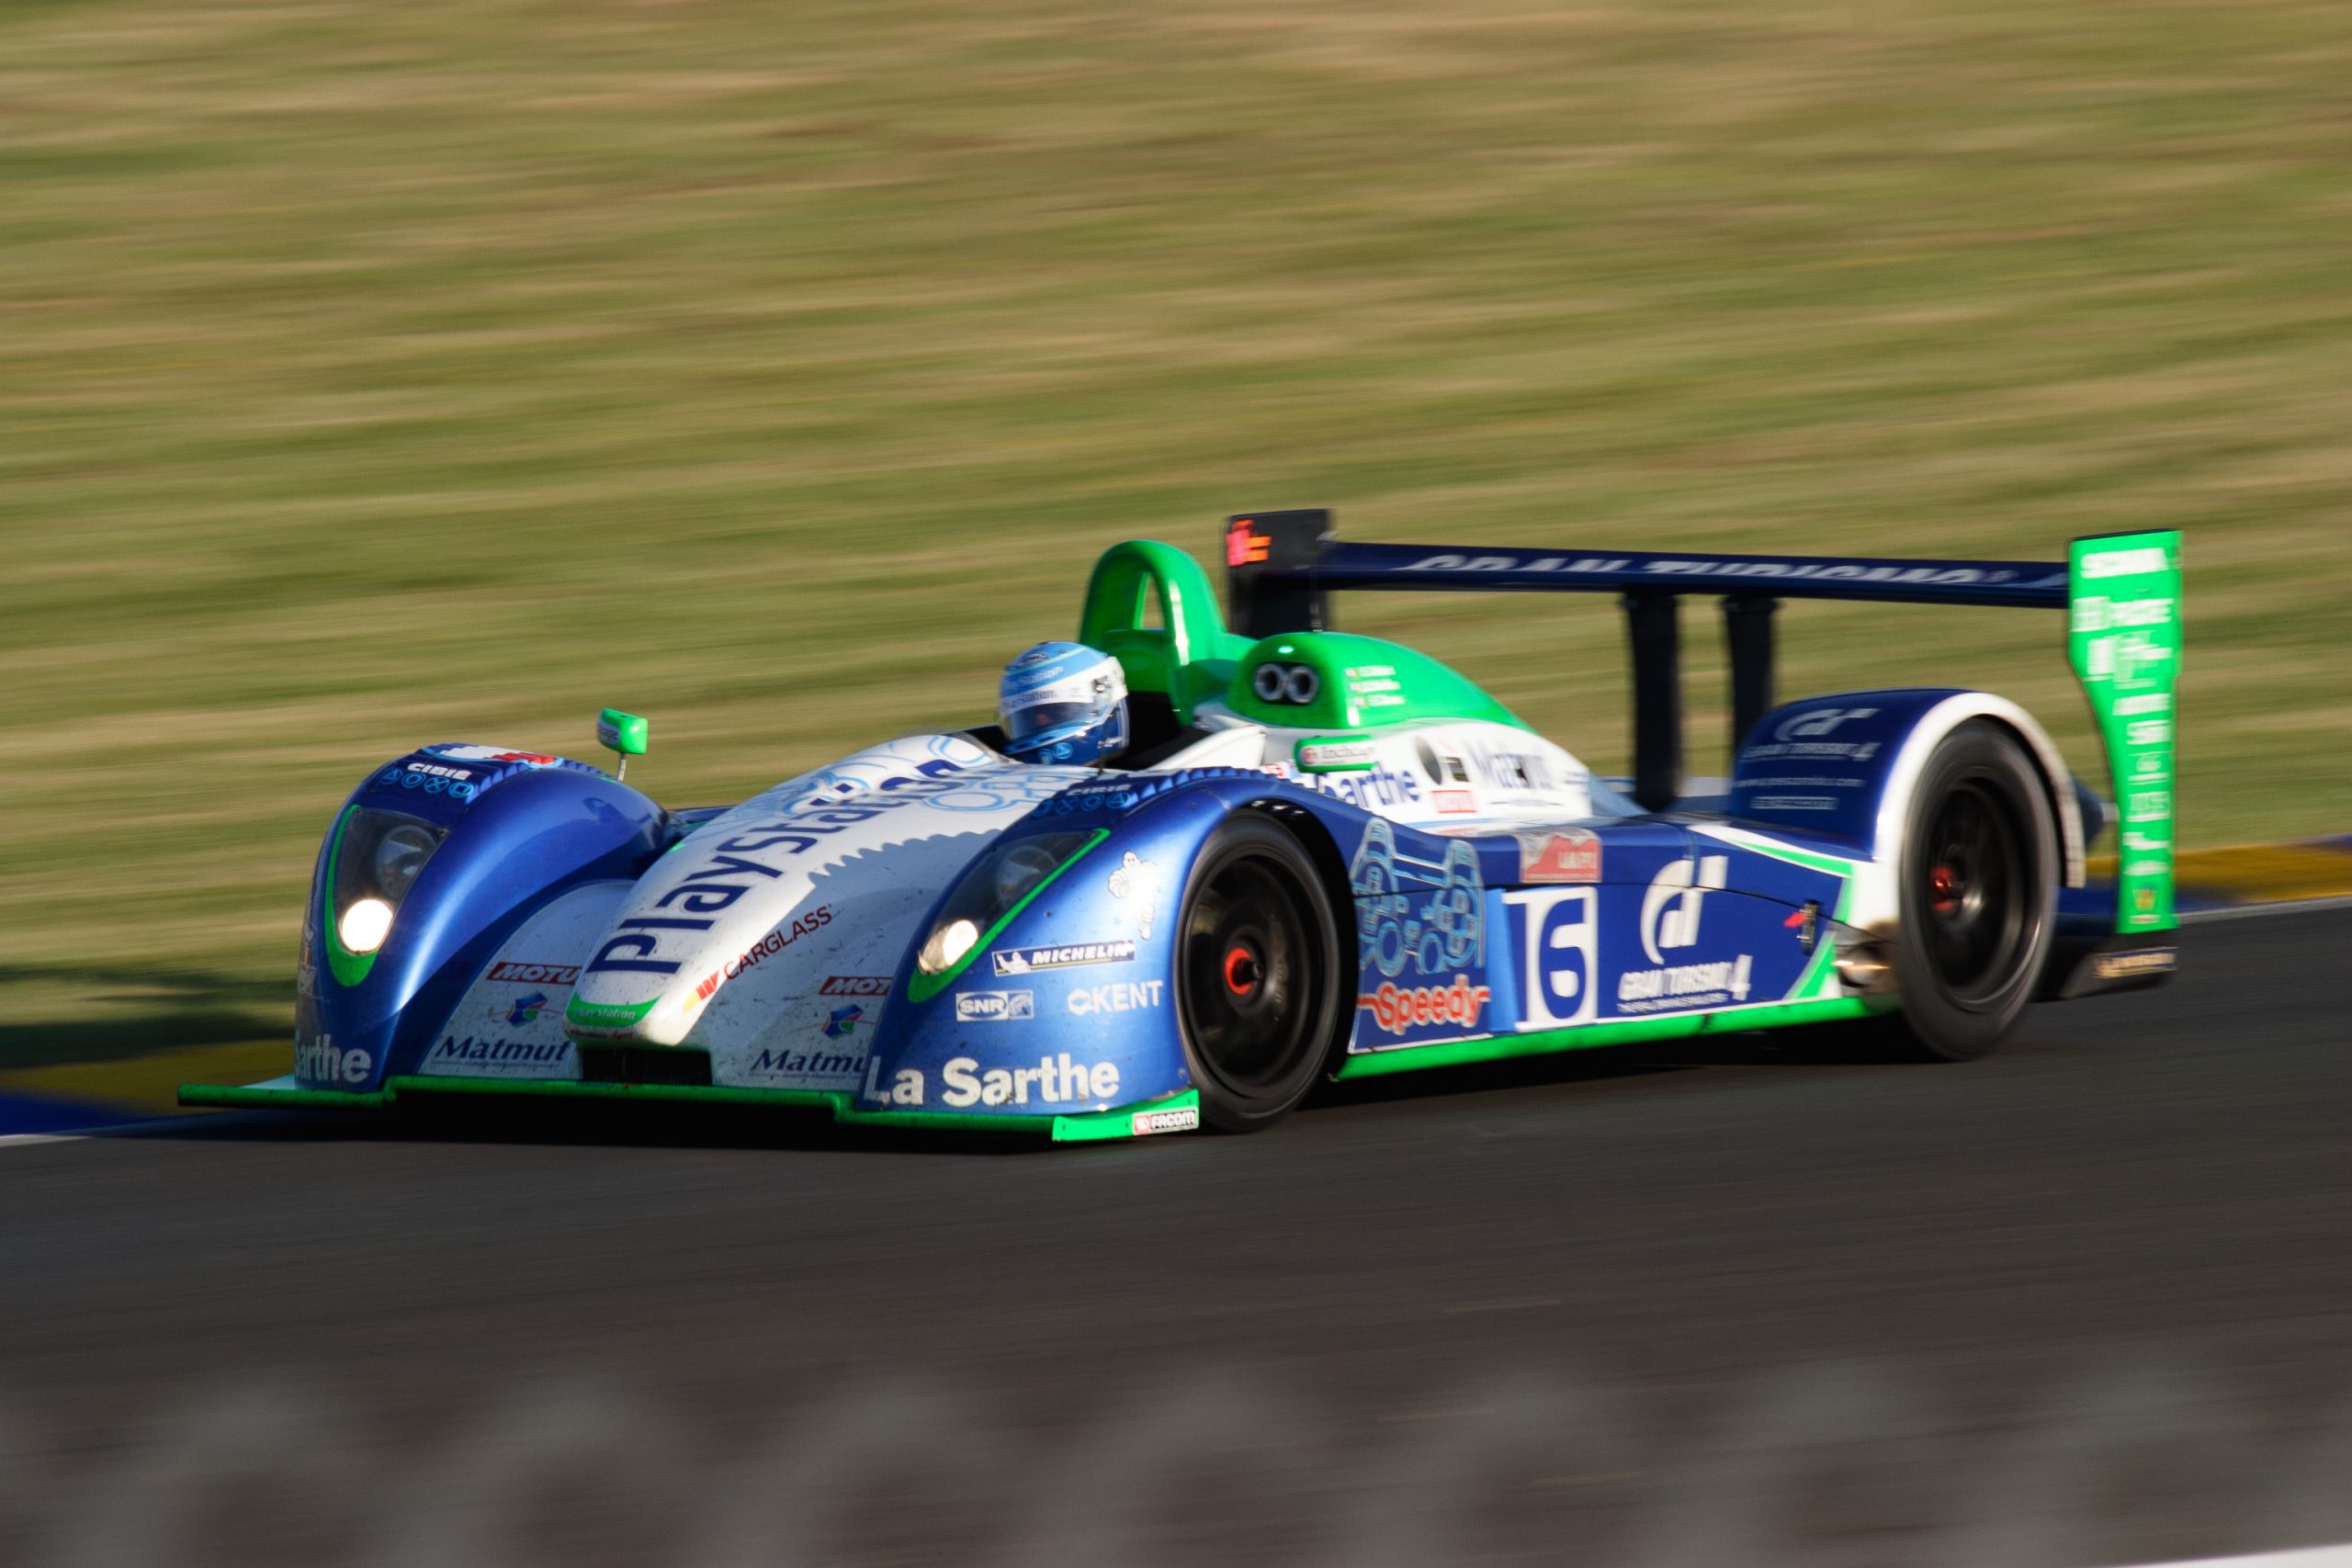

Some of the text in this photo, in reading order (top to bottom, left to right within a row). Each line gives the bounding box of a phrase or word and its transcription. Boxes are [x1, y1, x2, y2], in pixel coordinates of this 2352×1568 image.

[724, 905, 834, 981] CARGLASS
[1032, 942, 1135, 964] MICHELIN
[1502, 885, 1599, 1032] 16
[492, 964, 580, 983] MOTU
[824, 977, 892, 995] MOT
[960, 1000, 1005, 1014] SNR
[1092, 979, 1163, 1013] KENT
[1379, 975, 1490, 1035] Speedy
[435, 1035, 572, 1062] Matmut
[751, 1048, 866, 1073] Matm
[864, 1053, 1120, 1108] La Sarthe
[1150, 1111, 1195, 1130] FACOM
